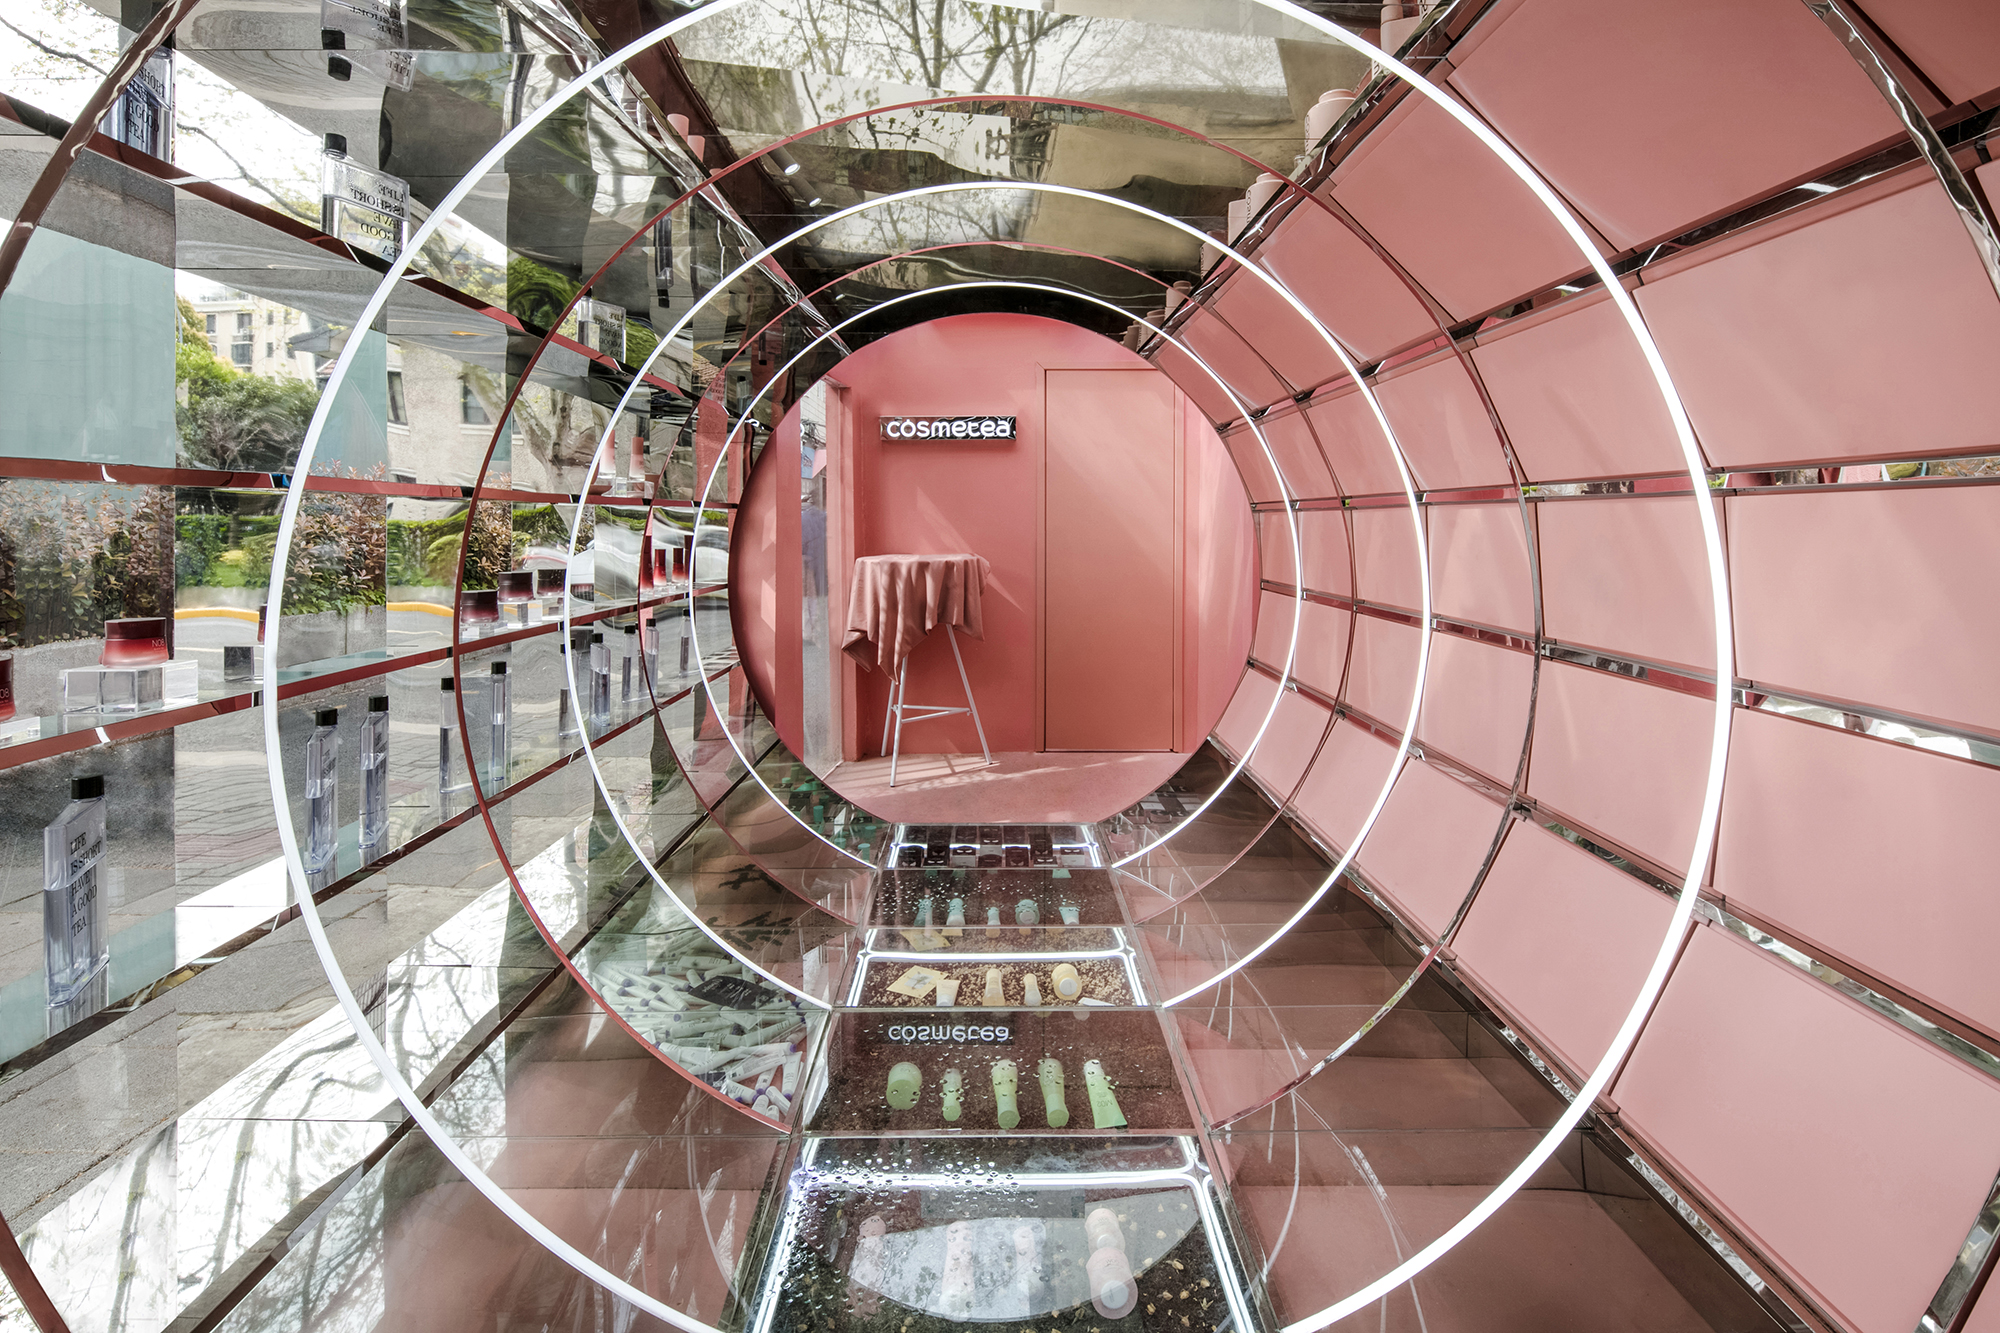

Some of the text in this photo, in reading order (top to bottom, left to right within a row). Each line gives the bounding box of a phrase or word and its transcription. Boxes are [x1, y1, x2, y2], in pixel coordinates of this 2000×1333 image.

[886, 419, 1011, 438] cosmetea
[70, 832, 87, 855] LIFE
[71, 870, 91, 897] HAVE
[72, 916, 87, 937] TEA
